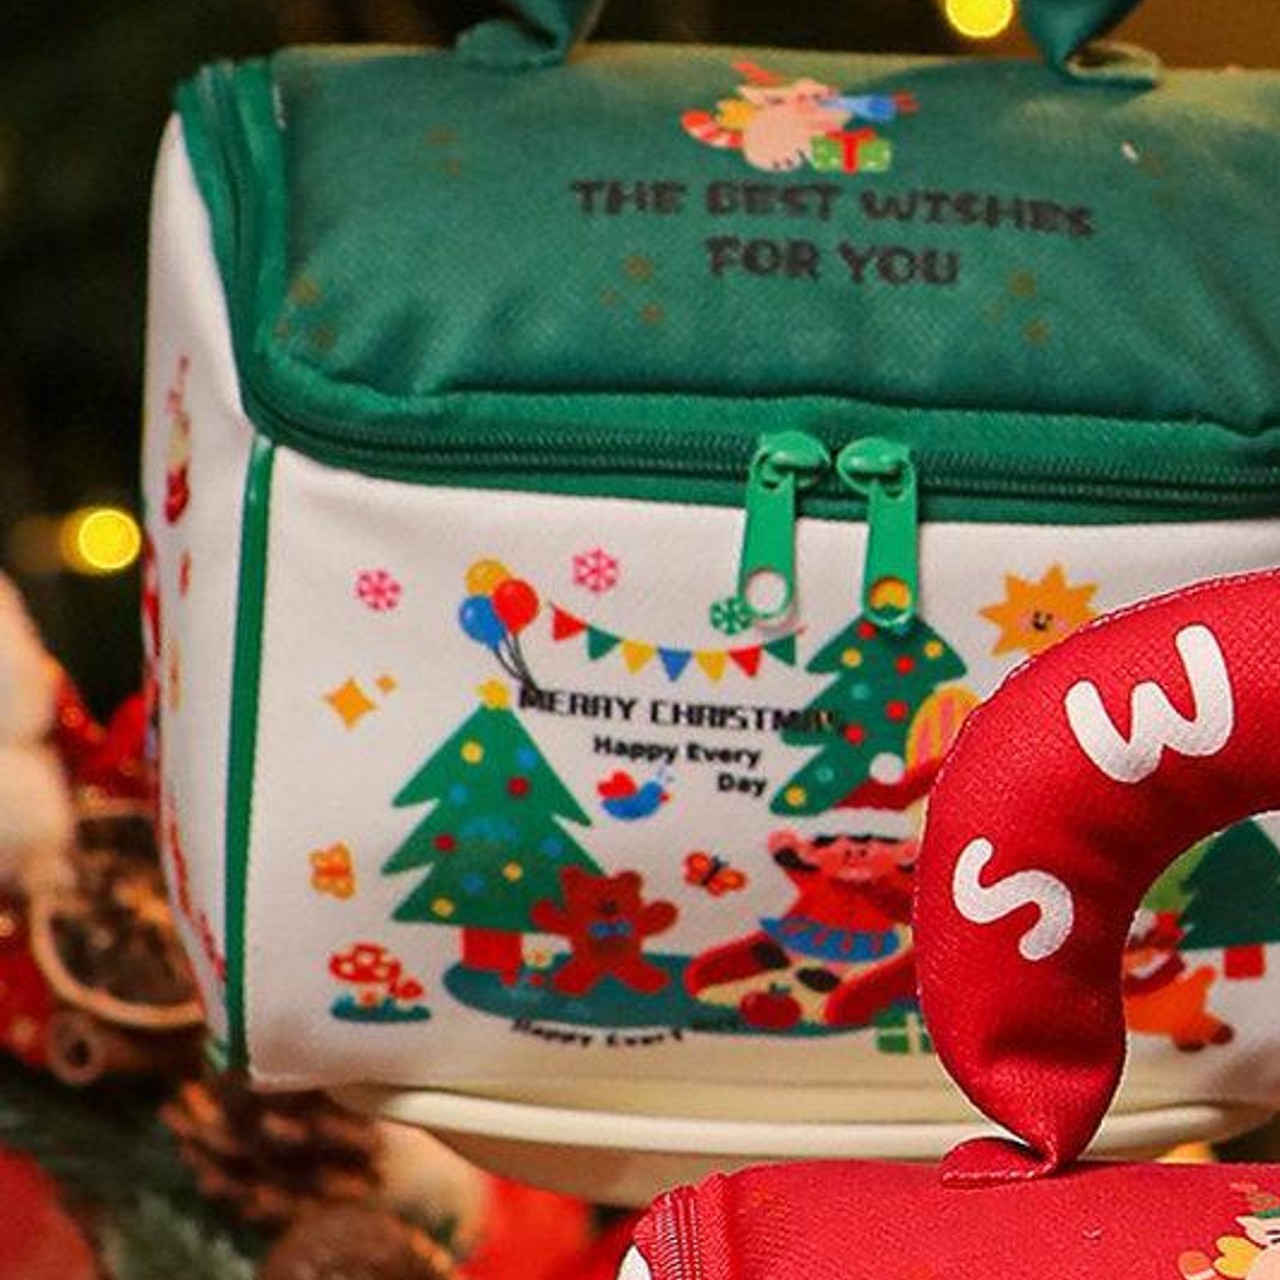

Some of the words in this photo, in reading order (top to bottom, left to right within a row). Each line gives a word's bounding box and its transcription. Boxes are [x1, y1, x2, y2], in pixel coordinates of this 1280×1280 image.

[570, 179, 686, 216] THE
[707, 181, 842, 220] BEST
[860, 191, 1095, 239] WISHES
[706, 234, 819, 280] FOR
[838, 242, 959, 286] YOU
[518, 686, 638, 721] MERRY
[593, 736, 679, 765] Happy
[686, 745, 762, 769] Every
[717, 772, 767, 798] Day
